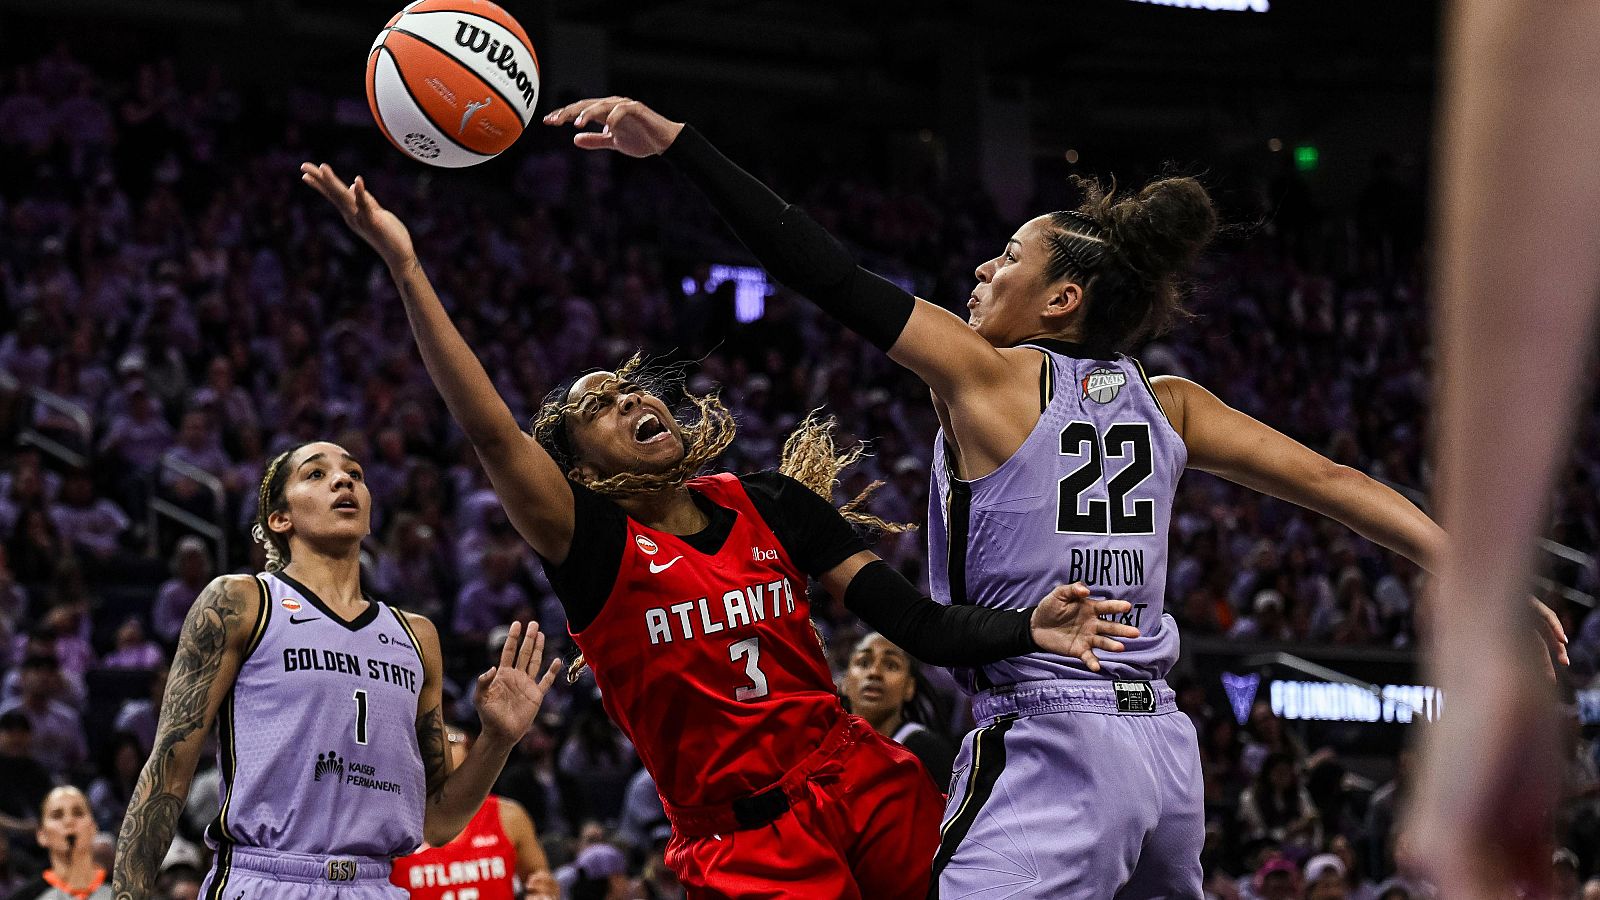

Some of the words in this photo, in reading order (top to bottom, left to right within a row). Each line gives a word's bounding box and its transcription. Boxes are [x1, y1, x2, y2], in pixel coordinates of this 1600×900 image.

[454, 19, 535, 109] Wilson
[1055, 420, 1155, 535] 22
[1069, 548, 1145, 586] BURTON
[644, 577, 796, 645] ATLANTA
[283, 648, 361, 677] GOLDEN
[369, 658, 417, 694] STATE
[728, 637, 769, 701] 3
[352, 689, 369, 746] 1
[346, 775, 402, 795] PERMANENTE
[348, 762, 376, 777] KAISER
[327, 859, 357, 881] GSV
[408, 856, 506, 889] ATLANTA
